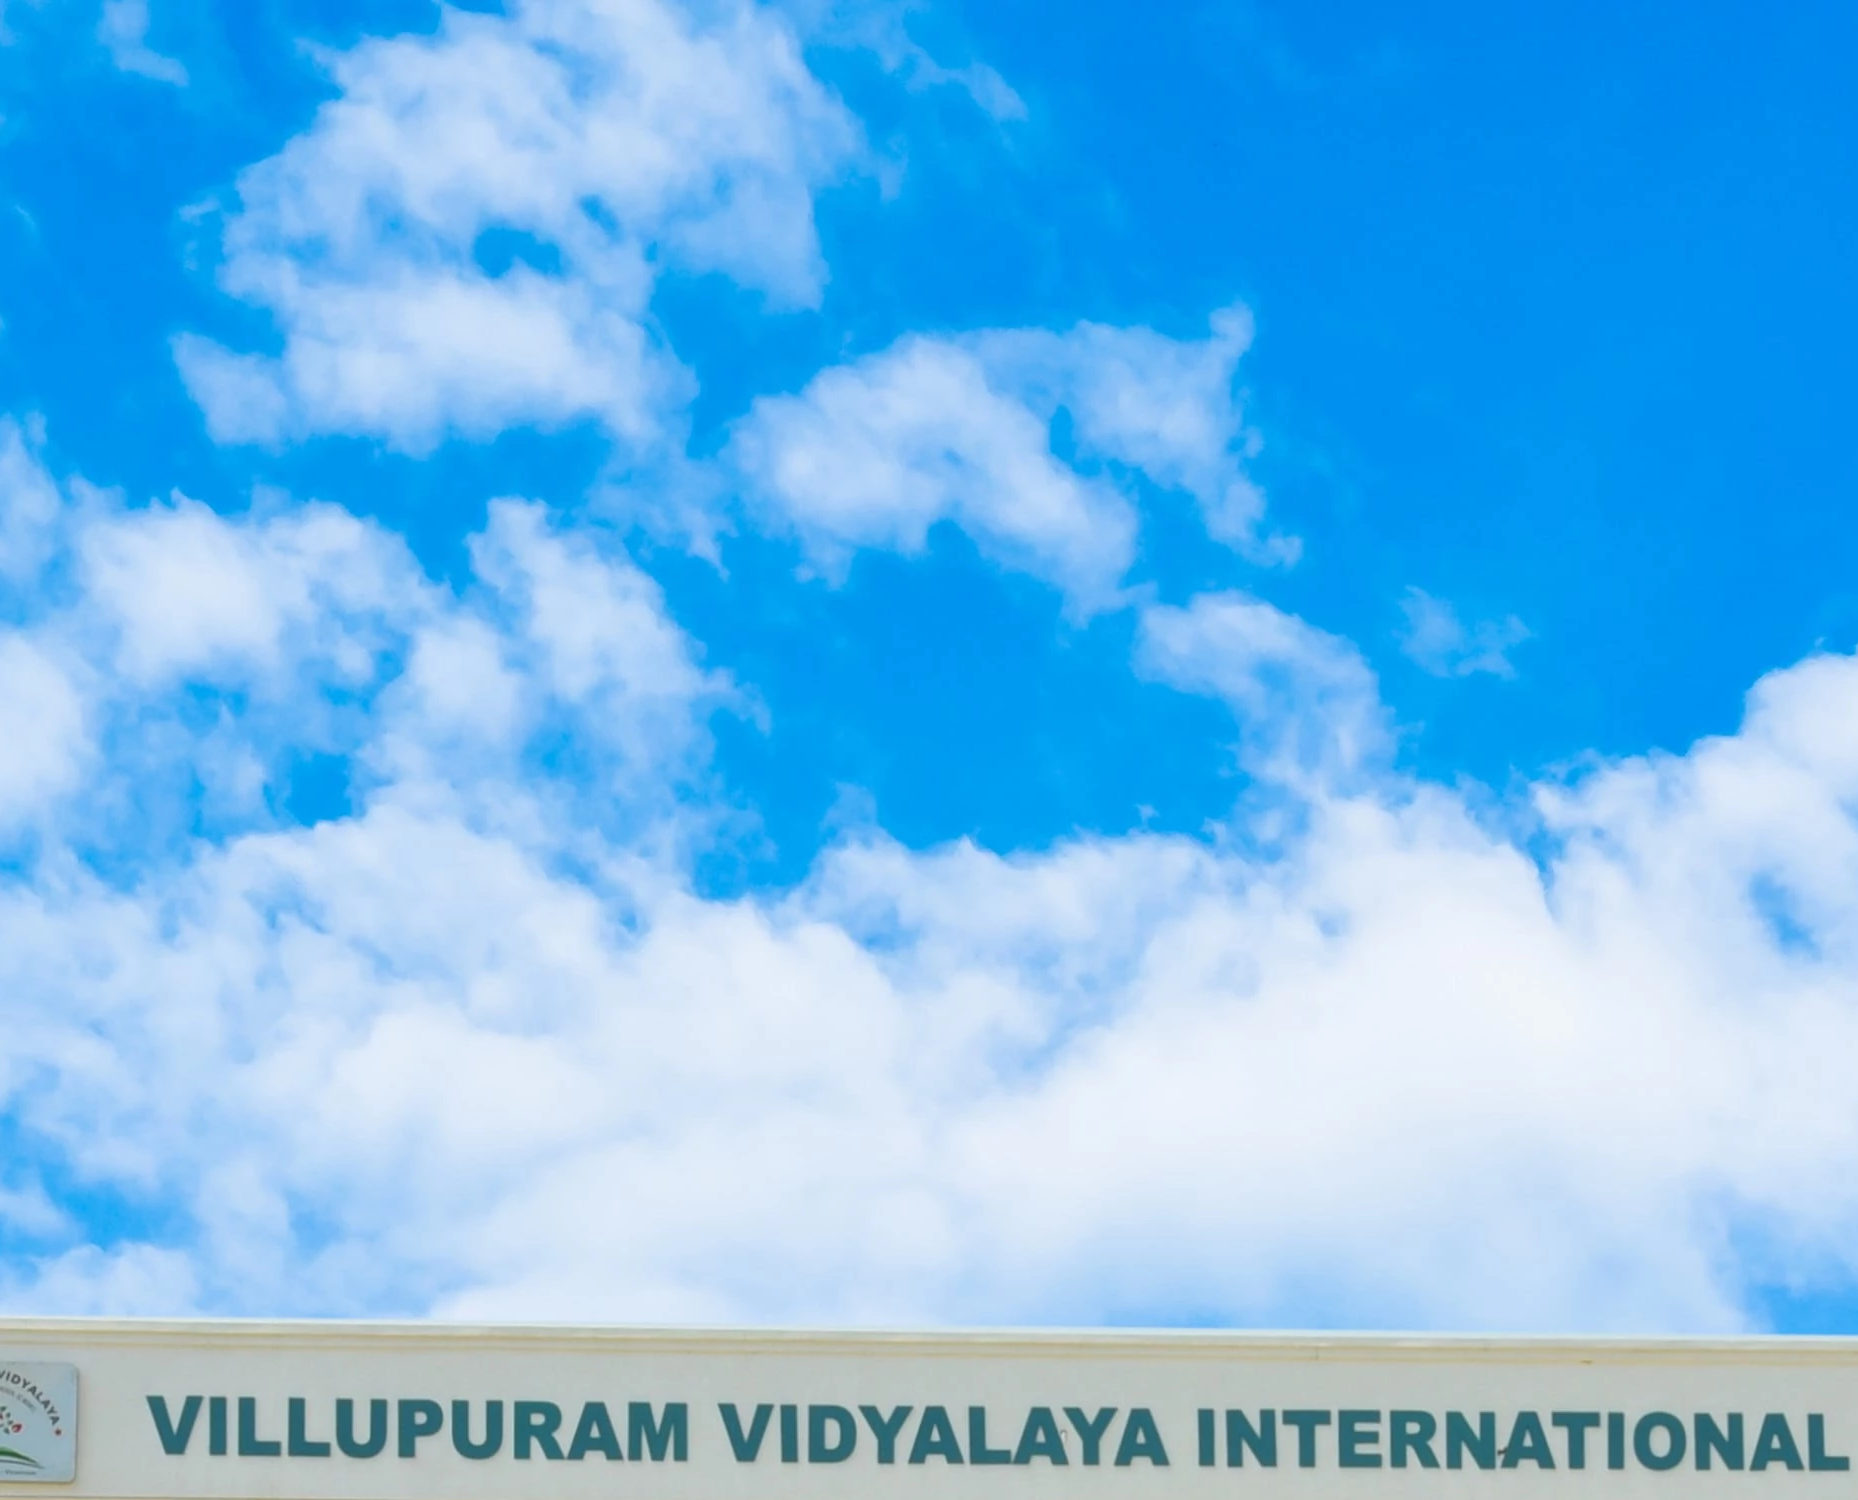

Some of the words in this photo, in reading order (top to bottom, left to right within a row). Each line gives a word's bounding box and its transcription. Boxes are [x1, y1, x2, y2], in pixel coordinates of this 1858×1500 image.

[148, 1395, 689, 1461] VILLUPURAM
[719, 1403, 1169, 1466] VIDYALAYA
[1197, 1408, 1850, 1472] INTERNATIONAL
